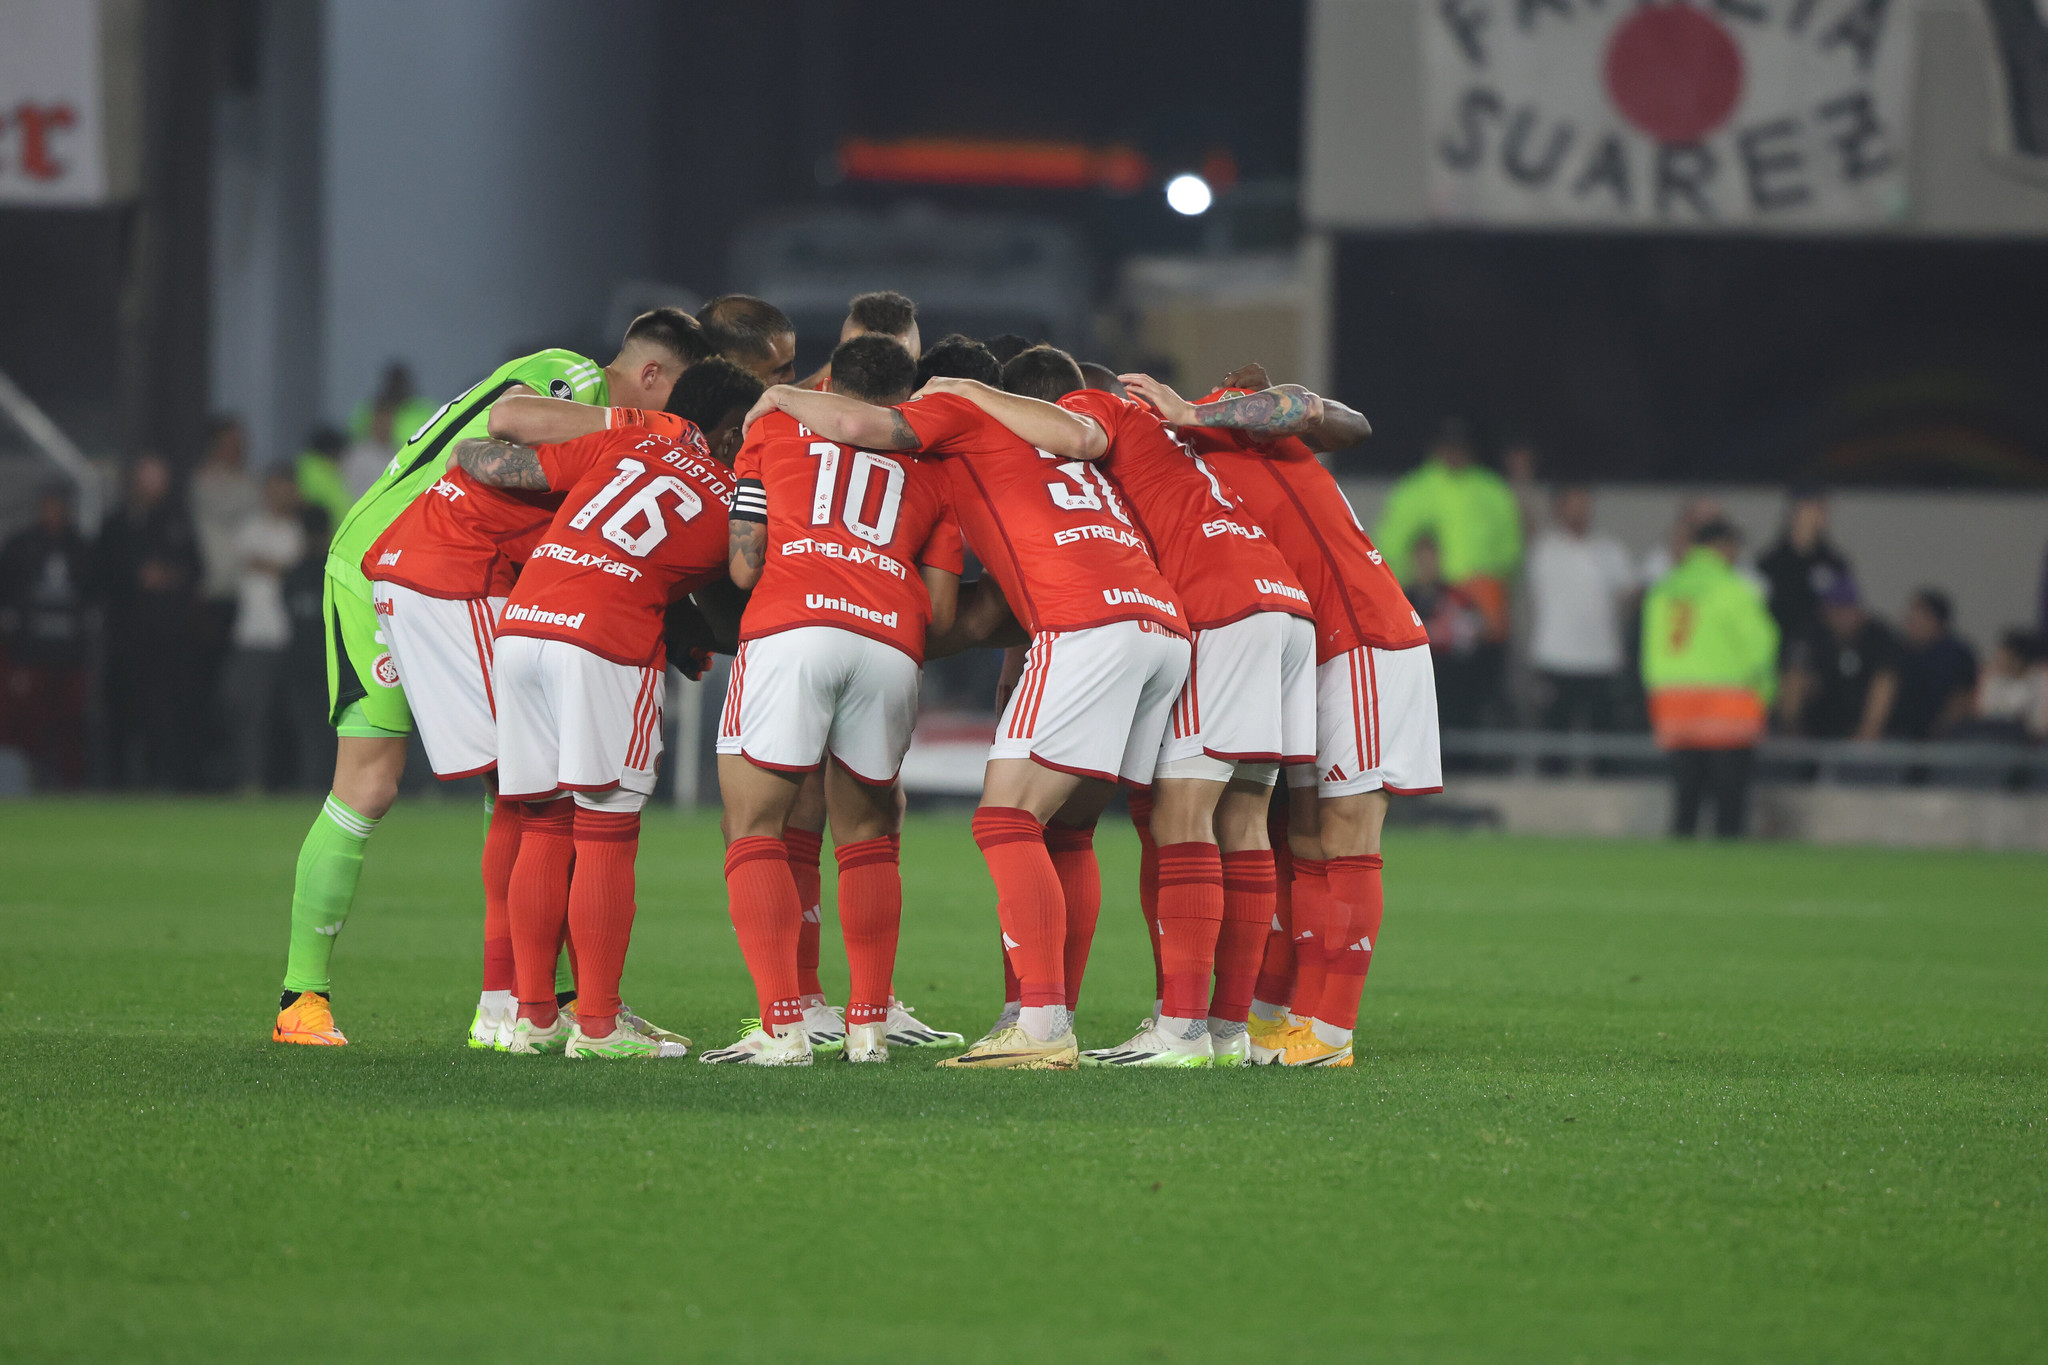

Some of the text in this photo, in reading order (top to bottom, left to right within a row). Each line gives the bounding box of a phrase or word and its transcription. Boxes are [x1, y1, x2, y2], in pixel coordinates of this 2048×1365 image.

[1437, 88, 1895, 216] SUAREZ
[634, 439, 656, 453] F.
[568, 457, 702, 557] 16
[809, 442, 905, 546] 10
[505, 604, 586, 630] Unimed
[805, 593, 898, 629] Unimed
[1102, 587, 1178, 618] Unimed
